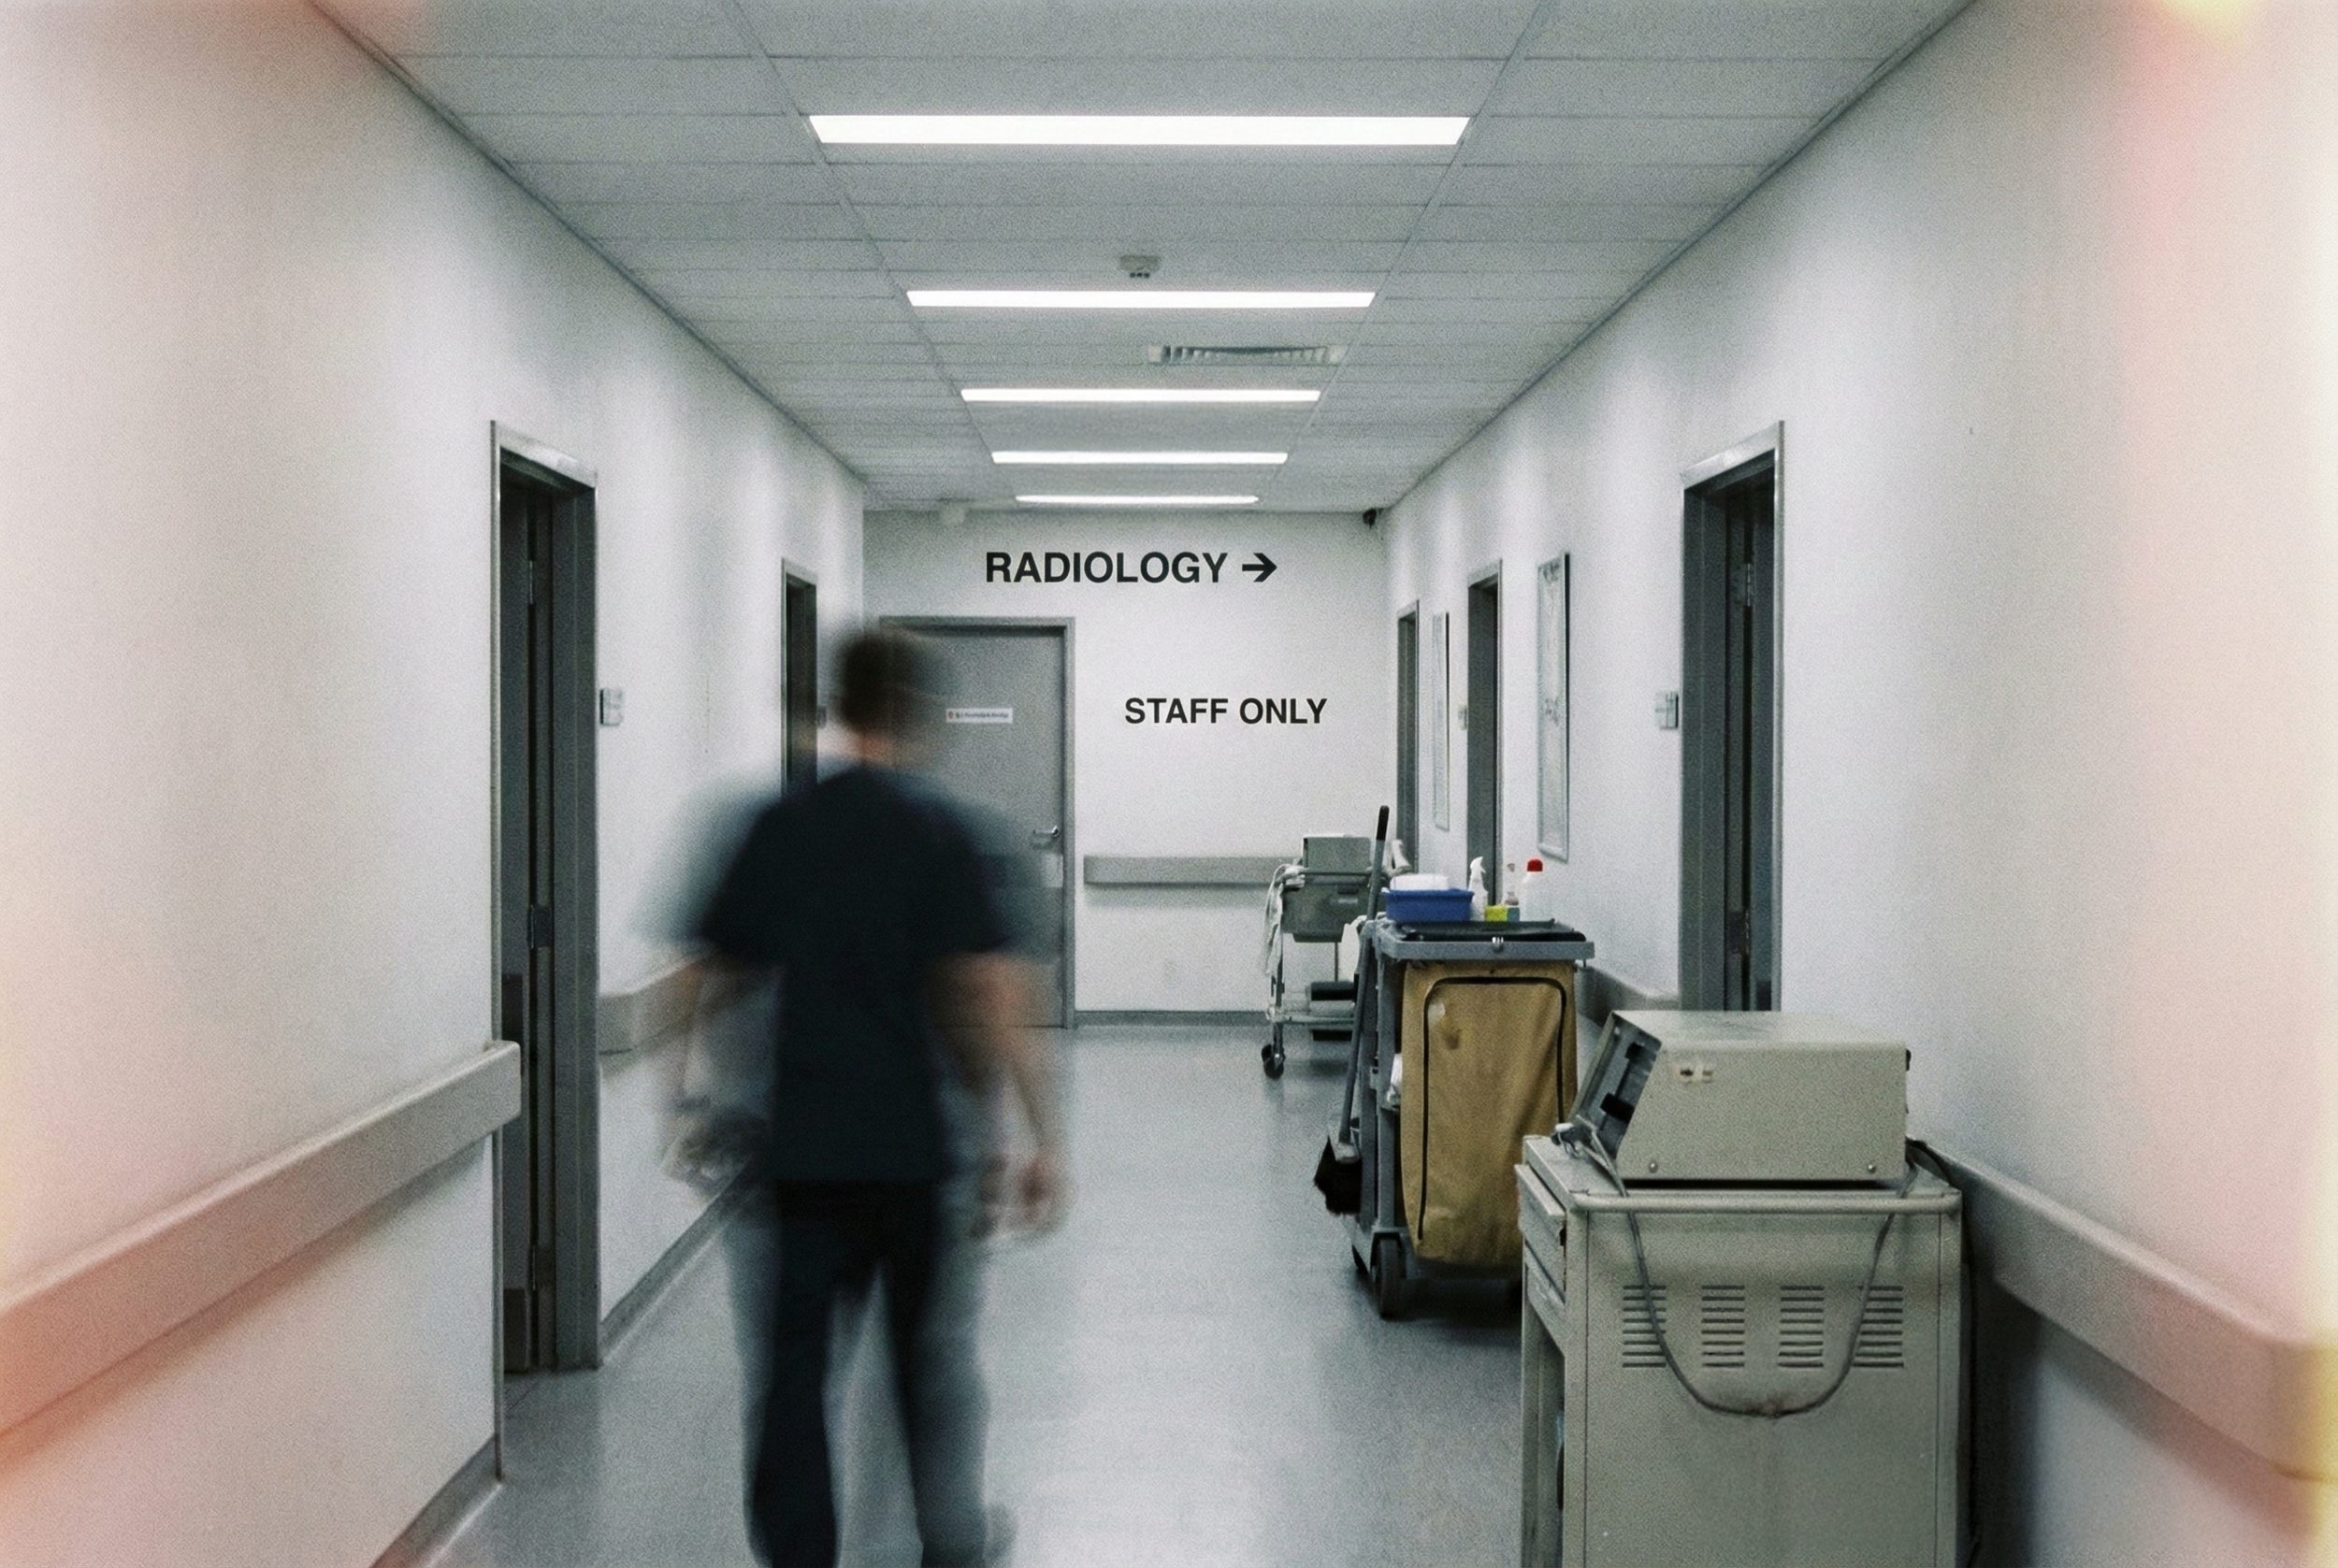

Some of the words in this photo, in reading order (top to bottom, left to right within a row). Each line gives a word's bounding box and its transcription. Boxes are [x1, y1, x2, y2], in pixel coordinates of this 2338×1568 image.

[986, 551, 1228, 583] RADIOLOGY
[1125, 698, 1229, 724] STAFF
[1239, 698, 1327, 724] ONLY
